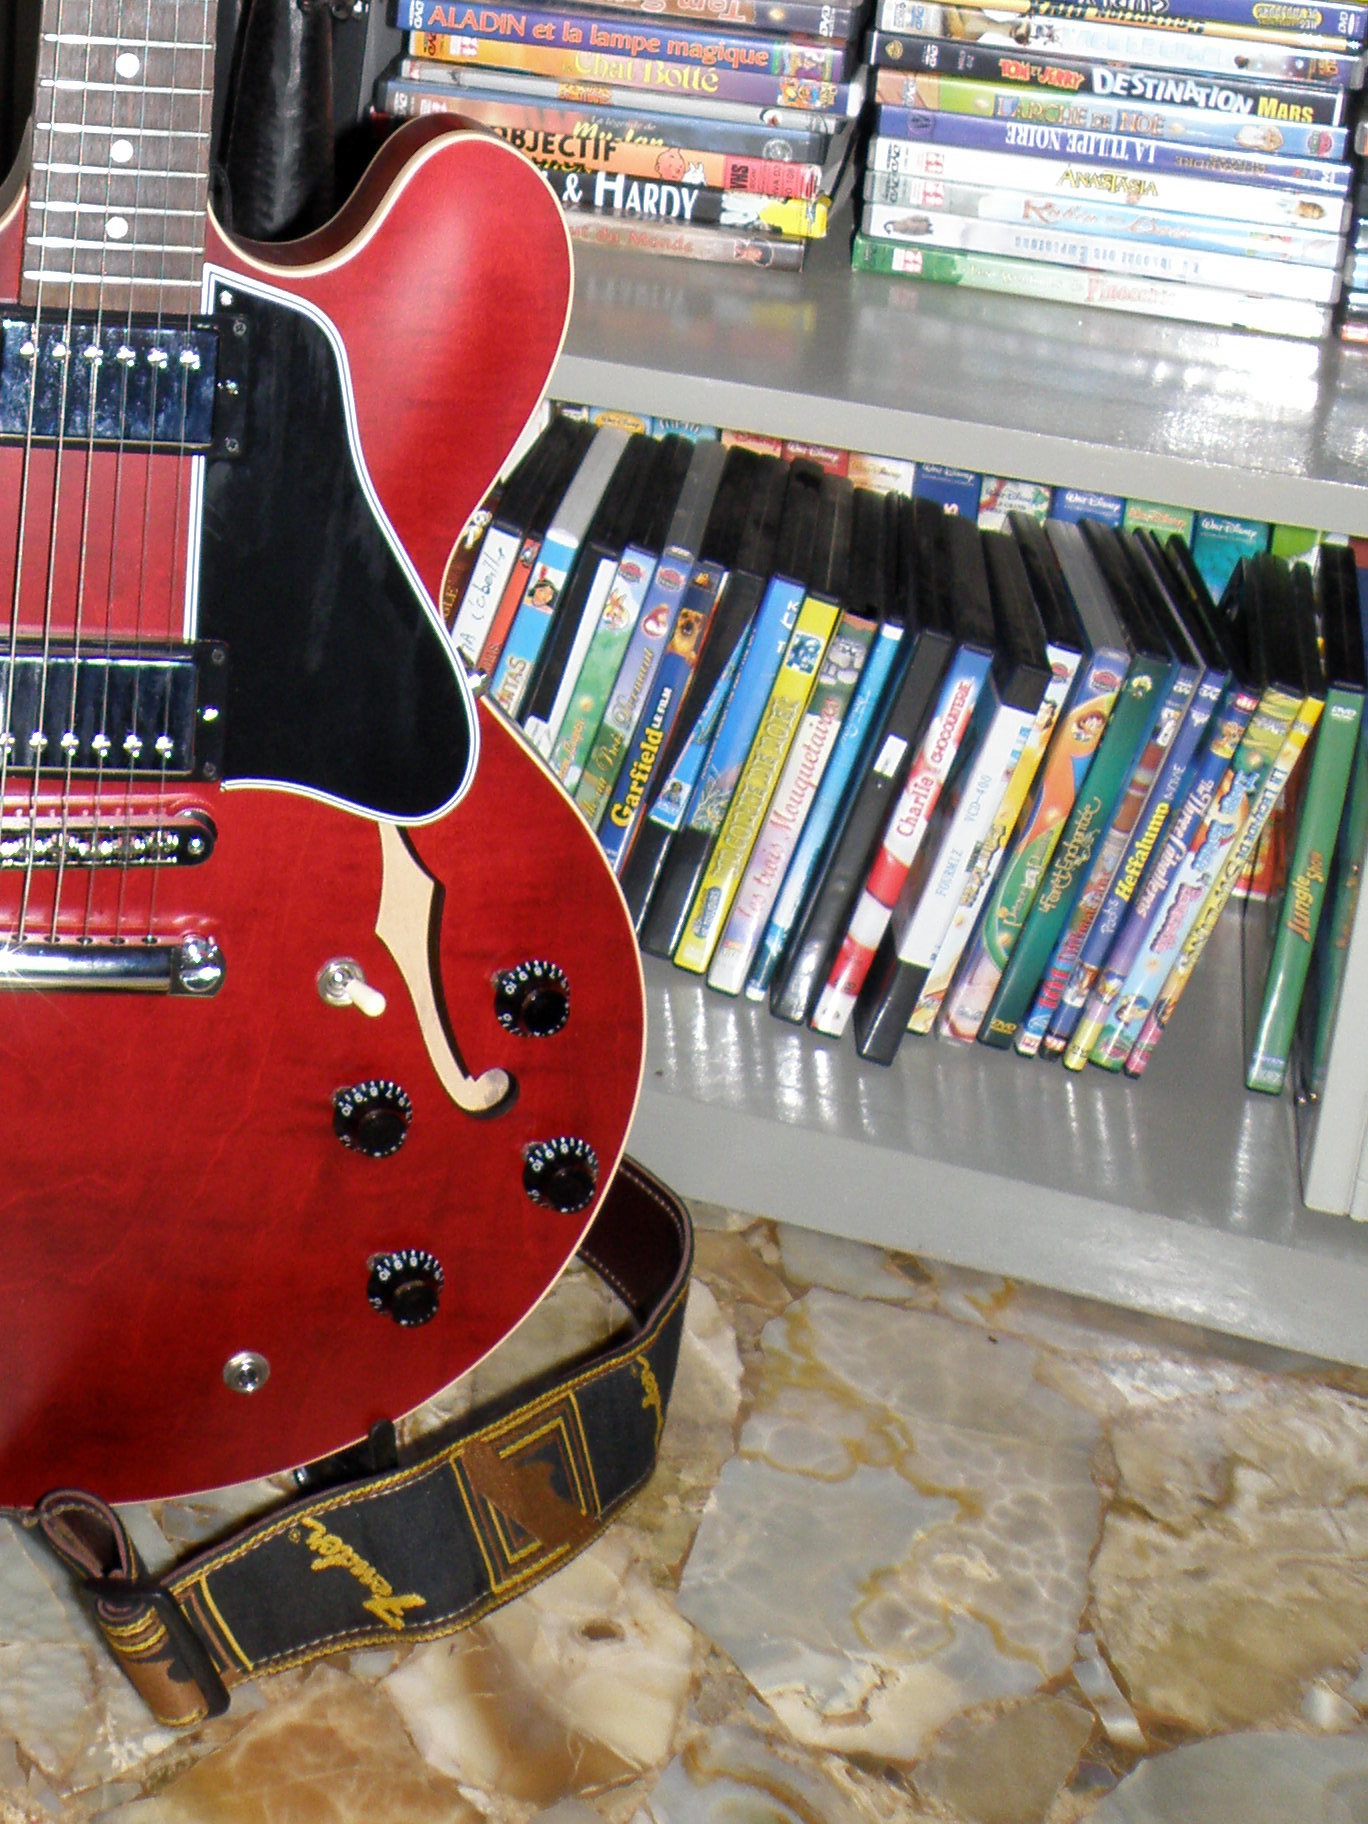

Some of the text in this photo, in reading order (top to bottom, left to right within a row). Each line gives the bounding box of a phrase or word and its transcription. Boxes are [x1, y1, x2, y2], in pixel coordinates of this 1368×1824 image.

[428, 5, 526, 36] ALADIN
[532, 21, 555, 42] et
[562, 20, 584, 43] la
[590, 22, 661, 56] lampe
[667, 39, 769, 69] magique
[1092, 67, 1255, 115] DESTINATION
[1256, 97, 1314, 125] MARS
[1005, 122, 1157, 164] LA TULIPE NOIRE
[593, 171, 699, 220] HARDY
[608, 688, 671, 828] Garfield LE FILM
[896, 774, 934, 837] Charlie
[1114, 799, 1169, 901] Heffalump
